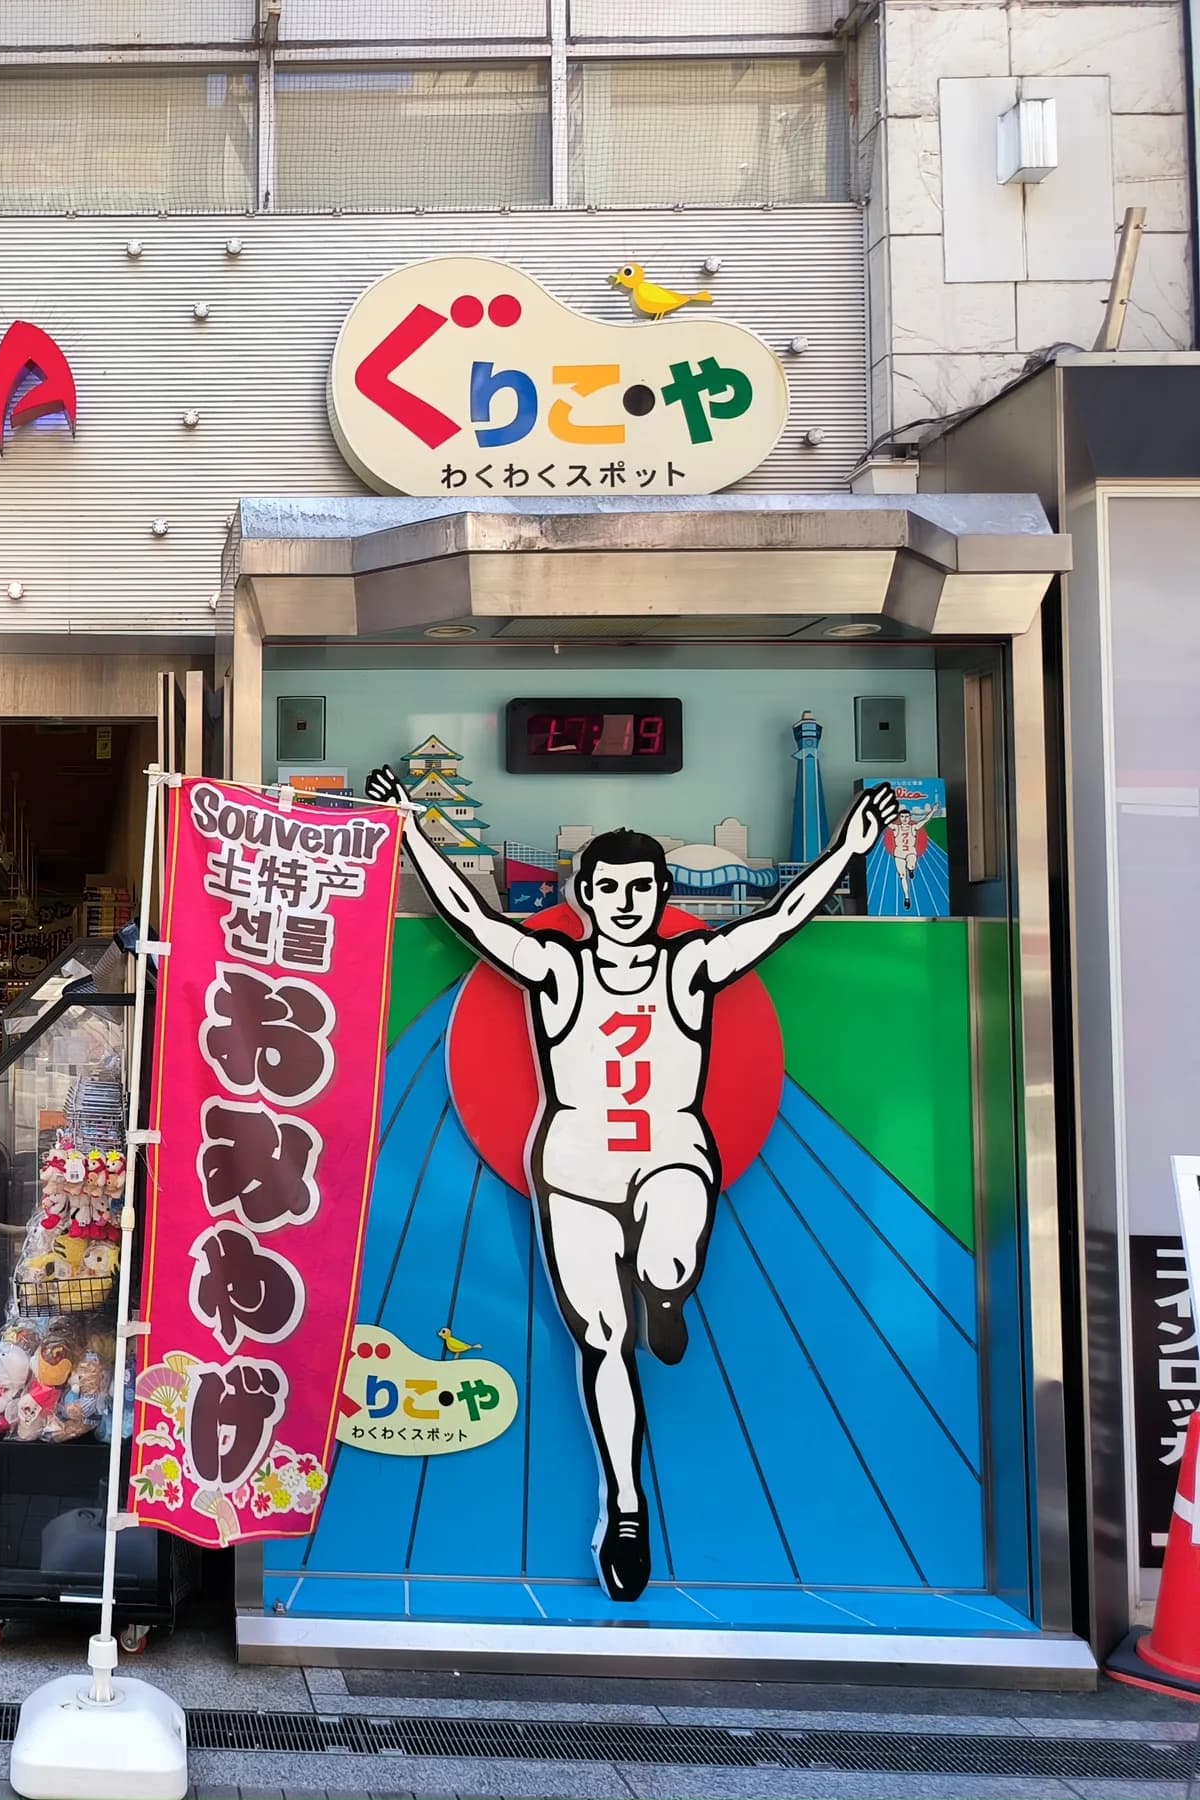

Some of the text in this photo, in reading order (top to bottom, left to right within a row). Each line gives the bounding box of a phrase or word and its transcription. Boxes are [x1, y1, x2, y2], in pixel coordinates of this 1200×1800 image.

[440, 461, 686, 489] わくわくスポット
[193, 786, 387, 860] Souvenir
[208, 849, 363, 909] 土特产
[227, 907, 328, 967] 선물
[599, 1004, 657, 1152] グリコ
[192, 968, 330, 1484] おみやげ
[352, 1426, 467, 1442] わくわくスポット
